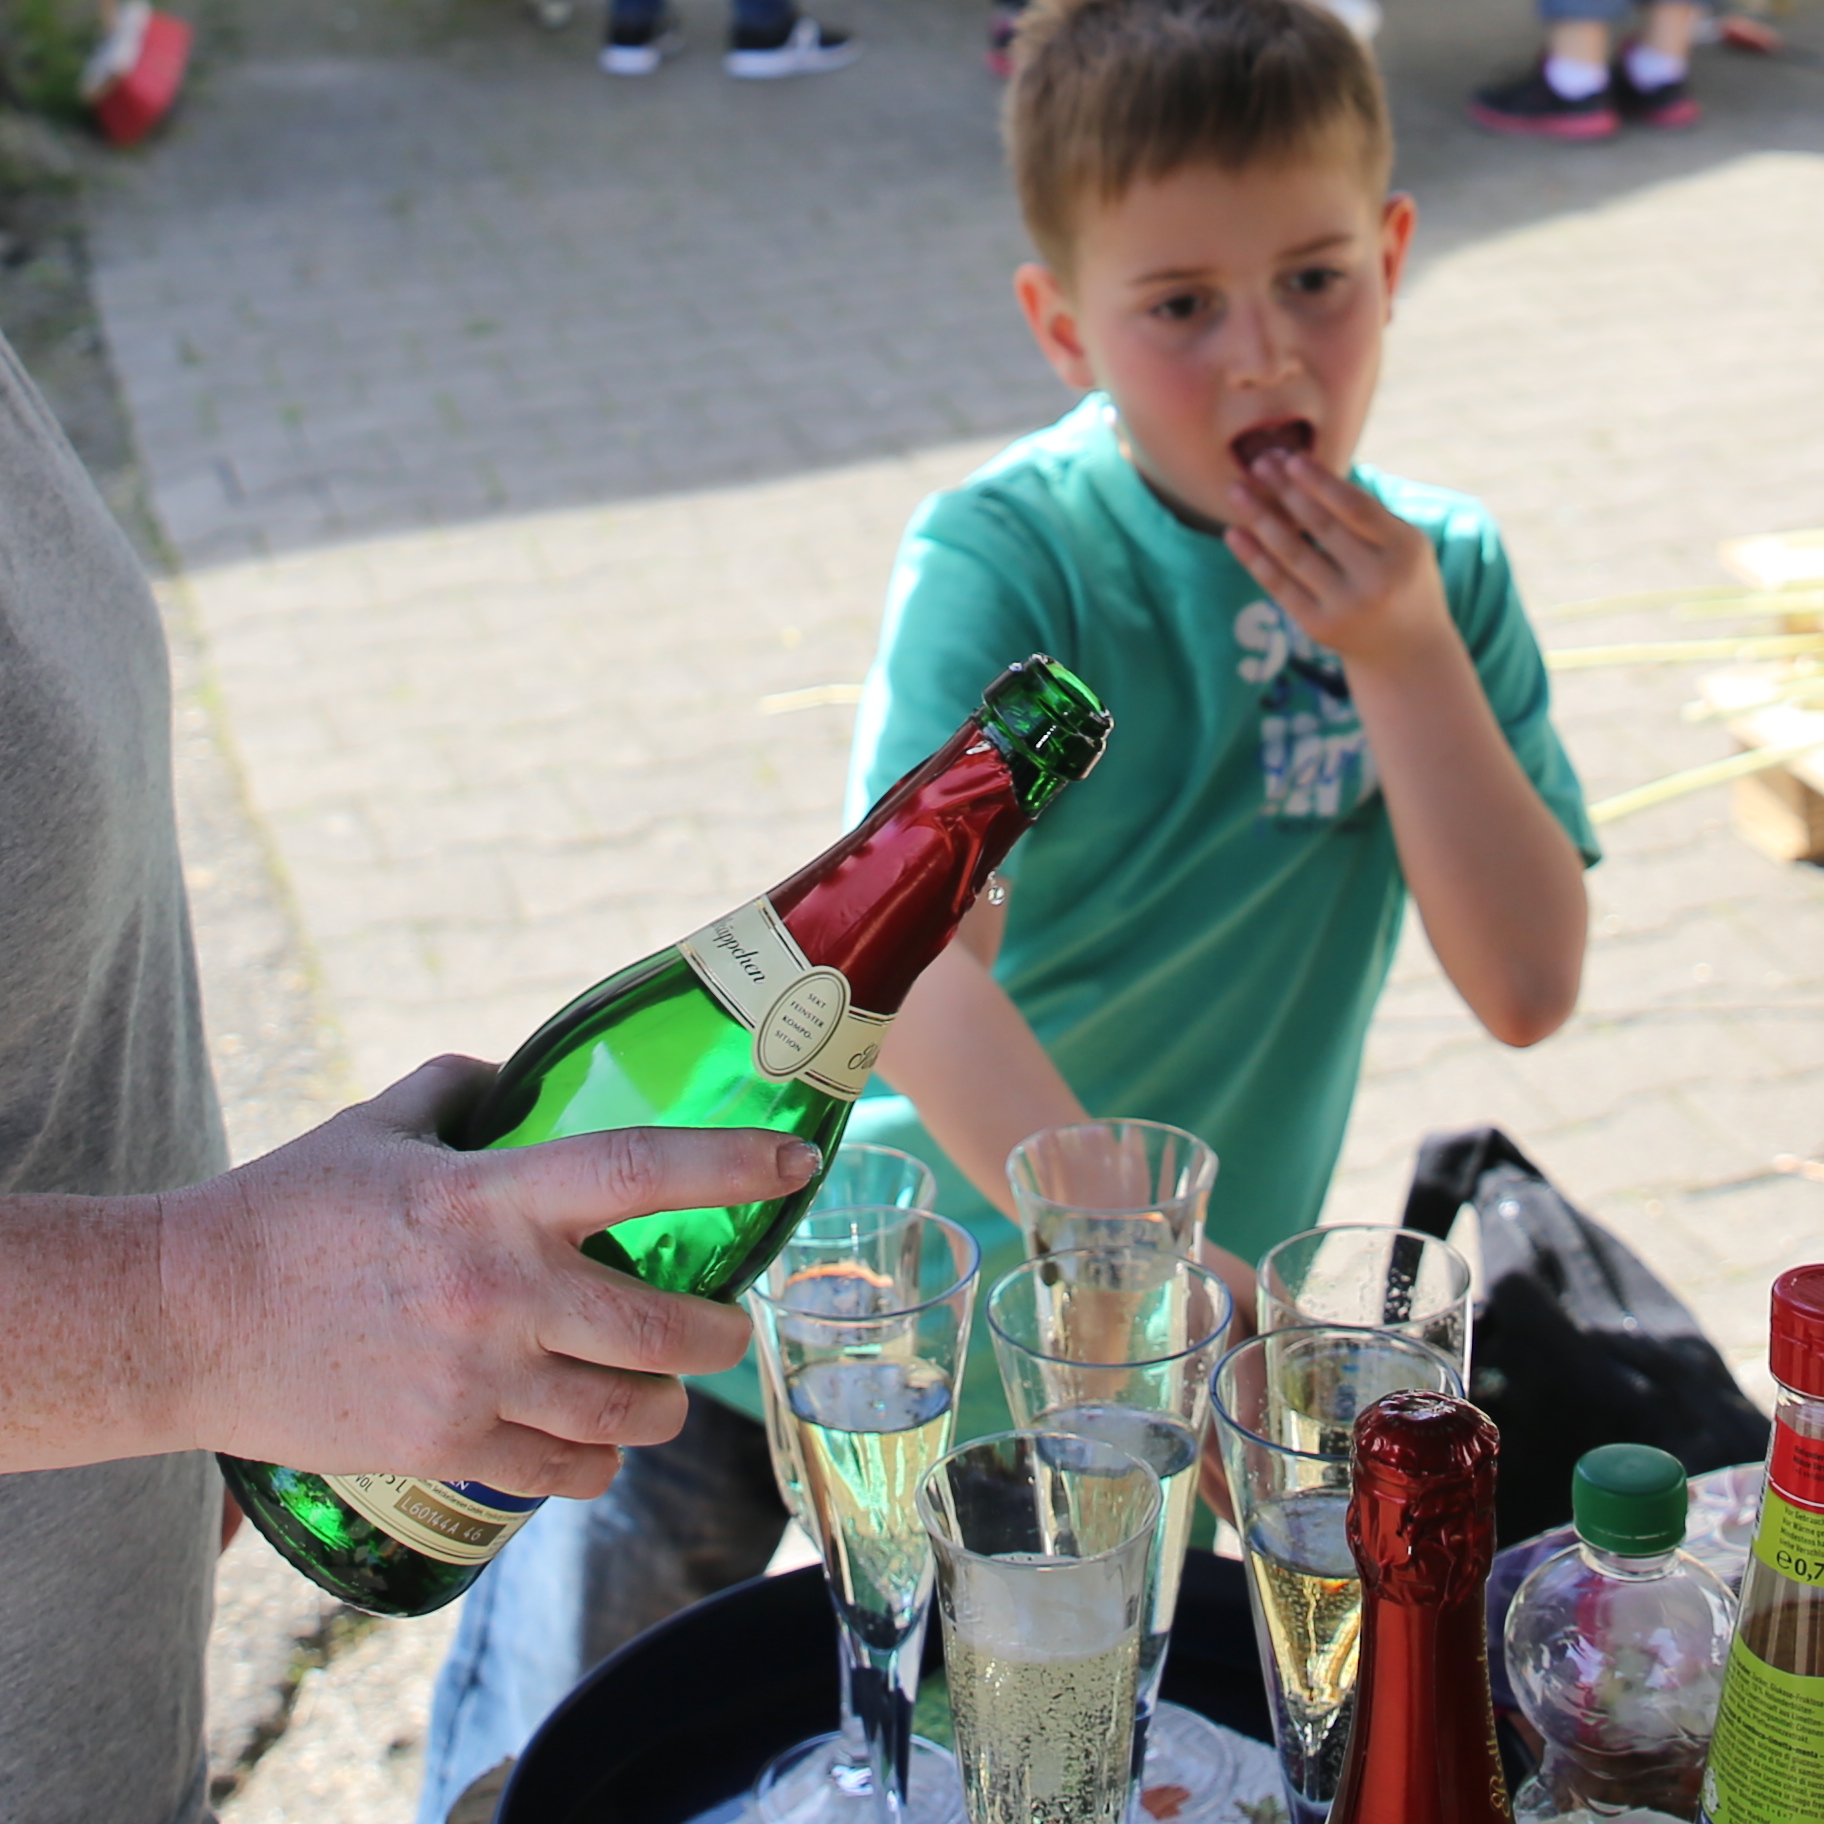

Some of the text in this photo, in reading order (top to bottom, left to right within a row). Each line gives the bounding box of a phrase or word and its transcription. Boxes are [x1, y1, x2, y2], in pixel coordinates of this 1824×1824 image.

[808, 992, 827, 1009] SEKT
[782, 1014, 813, 1041] KOMPO-
[790, 1000, 825, 1029] FEINSTER
[774, 1030, 802, 1053] SITION
[400, 1495, 462, 1536] L60144A
[463, 1525, 484, 1542] 46
